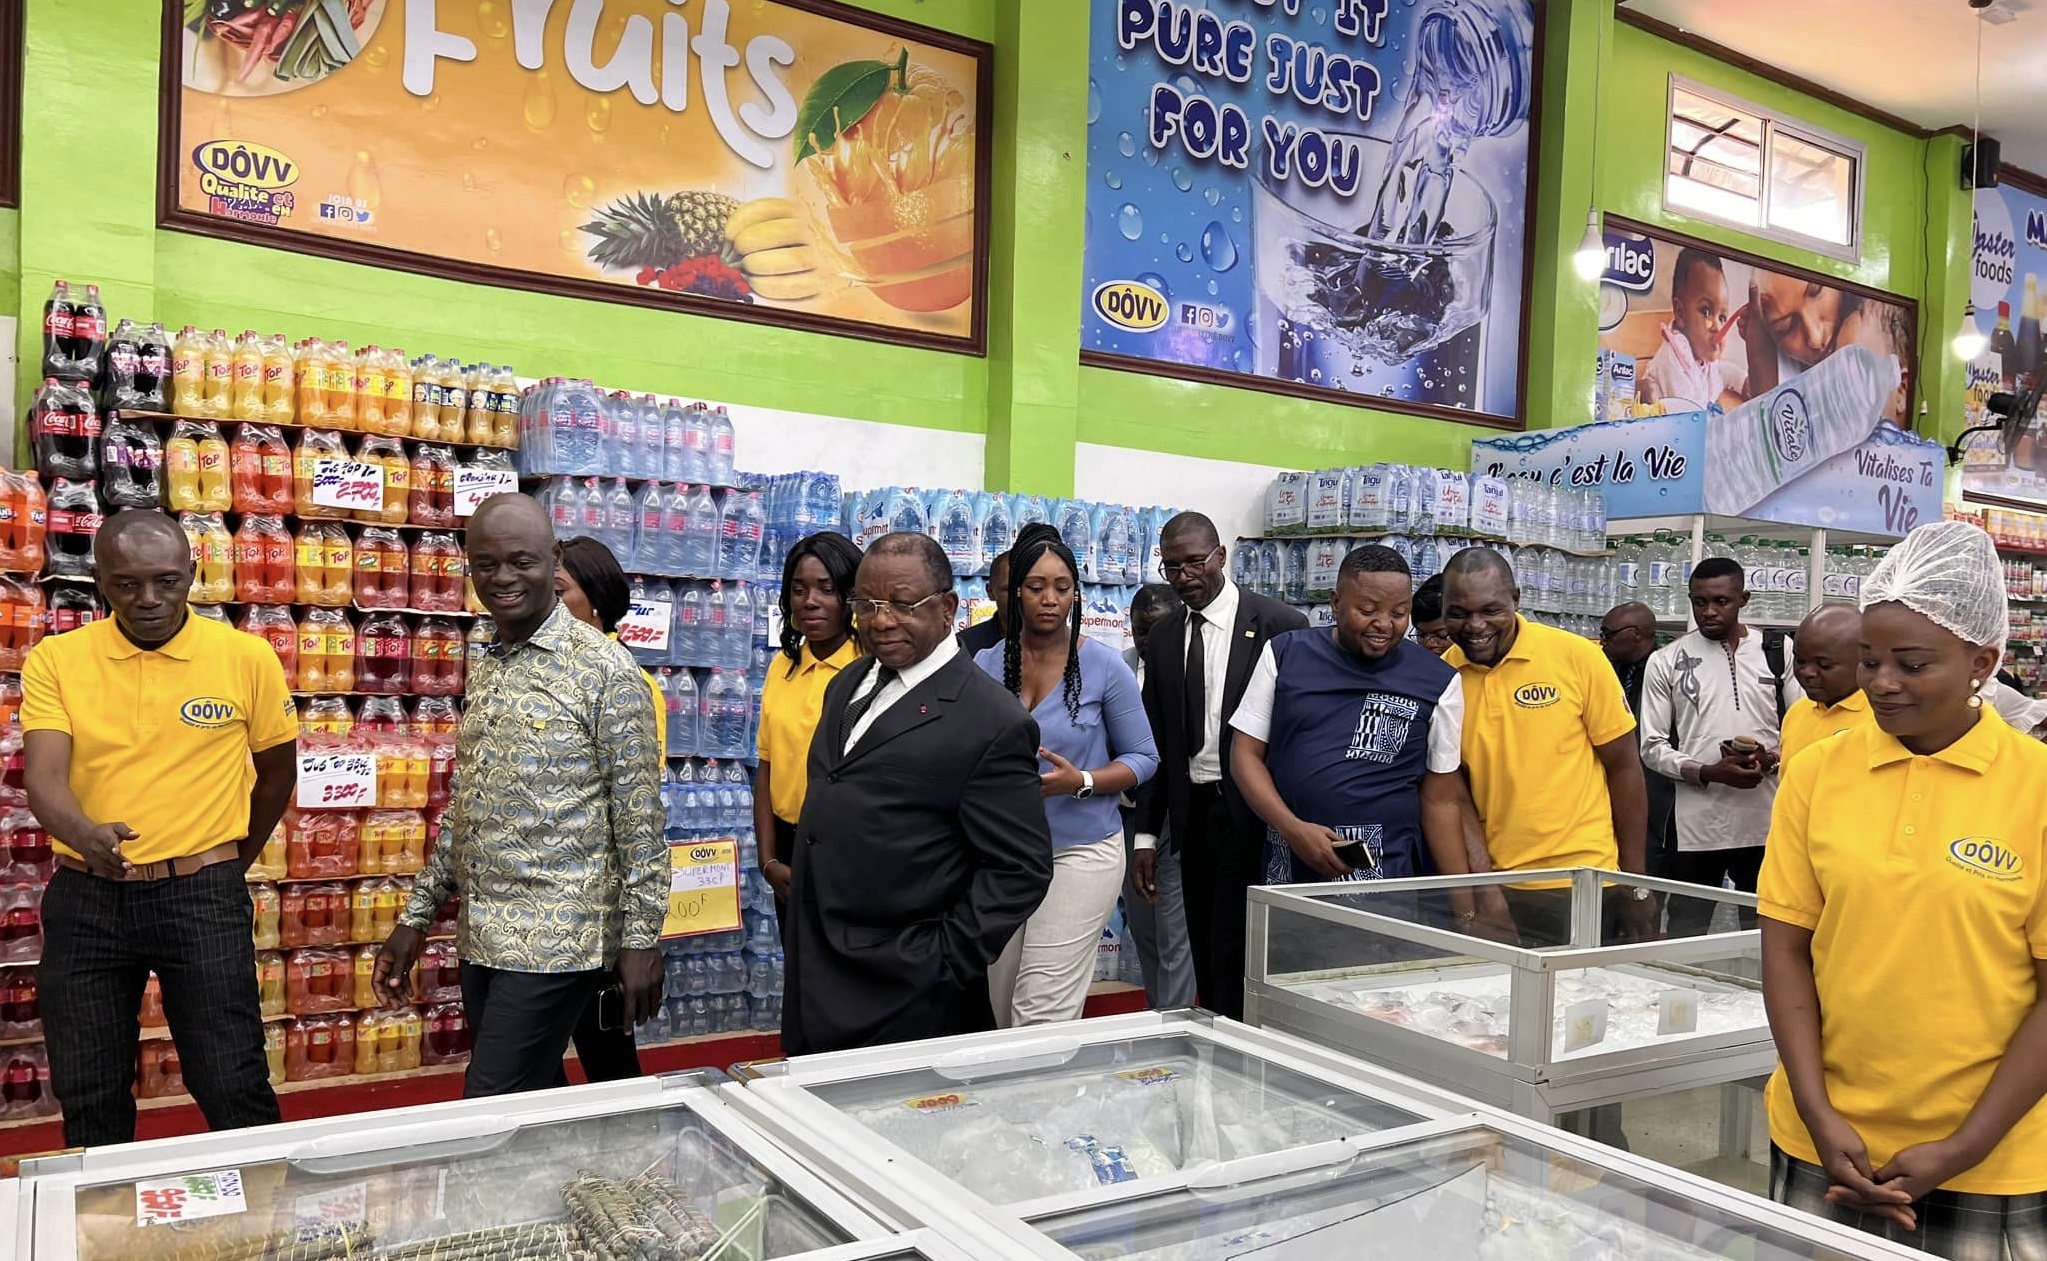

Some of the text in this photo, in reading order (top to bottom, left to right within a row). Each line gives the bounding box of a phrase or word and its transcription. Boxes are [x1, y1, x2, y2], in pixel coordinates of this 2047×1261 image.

[1118, 0, 1256, 83] PURE
[1266, 33, 1381, 121] JUST
[1150, 83, 1252, 168] FOR
[211, 145, 292, 182] DÔVV
[1261, 116, 1360, 197] YOU
[1606, 242, 1652, 278] rilac
[1975, 253, 2012, 285] foods
[1108, 288, 1162, 322] DÔVV
[201, 453, 220, 469] TOP
[390, 471, 408, 484] TOP
[1612, 452, 1635, 482] la
[1643, 445, 1687, 480] Vie
[1855, 448, 1933, 487] Vitalises Ta
[1878, 483, 1919, 533] Vie
[191, 700, 234, 720] DÔVV
[1522, 685, 1556, 701] DÔVV
[1964, 840, 2018, 870] DÔVV
